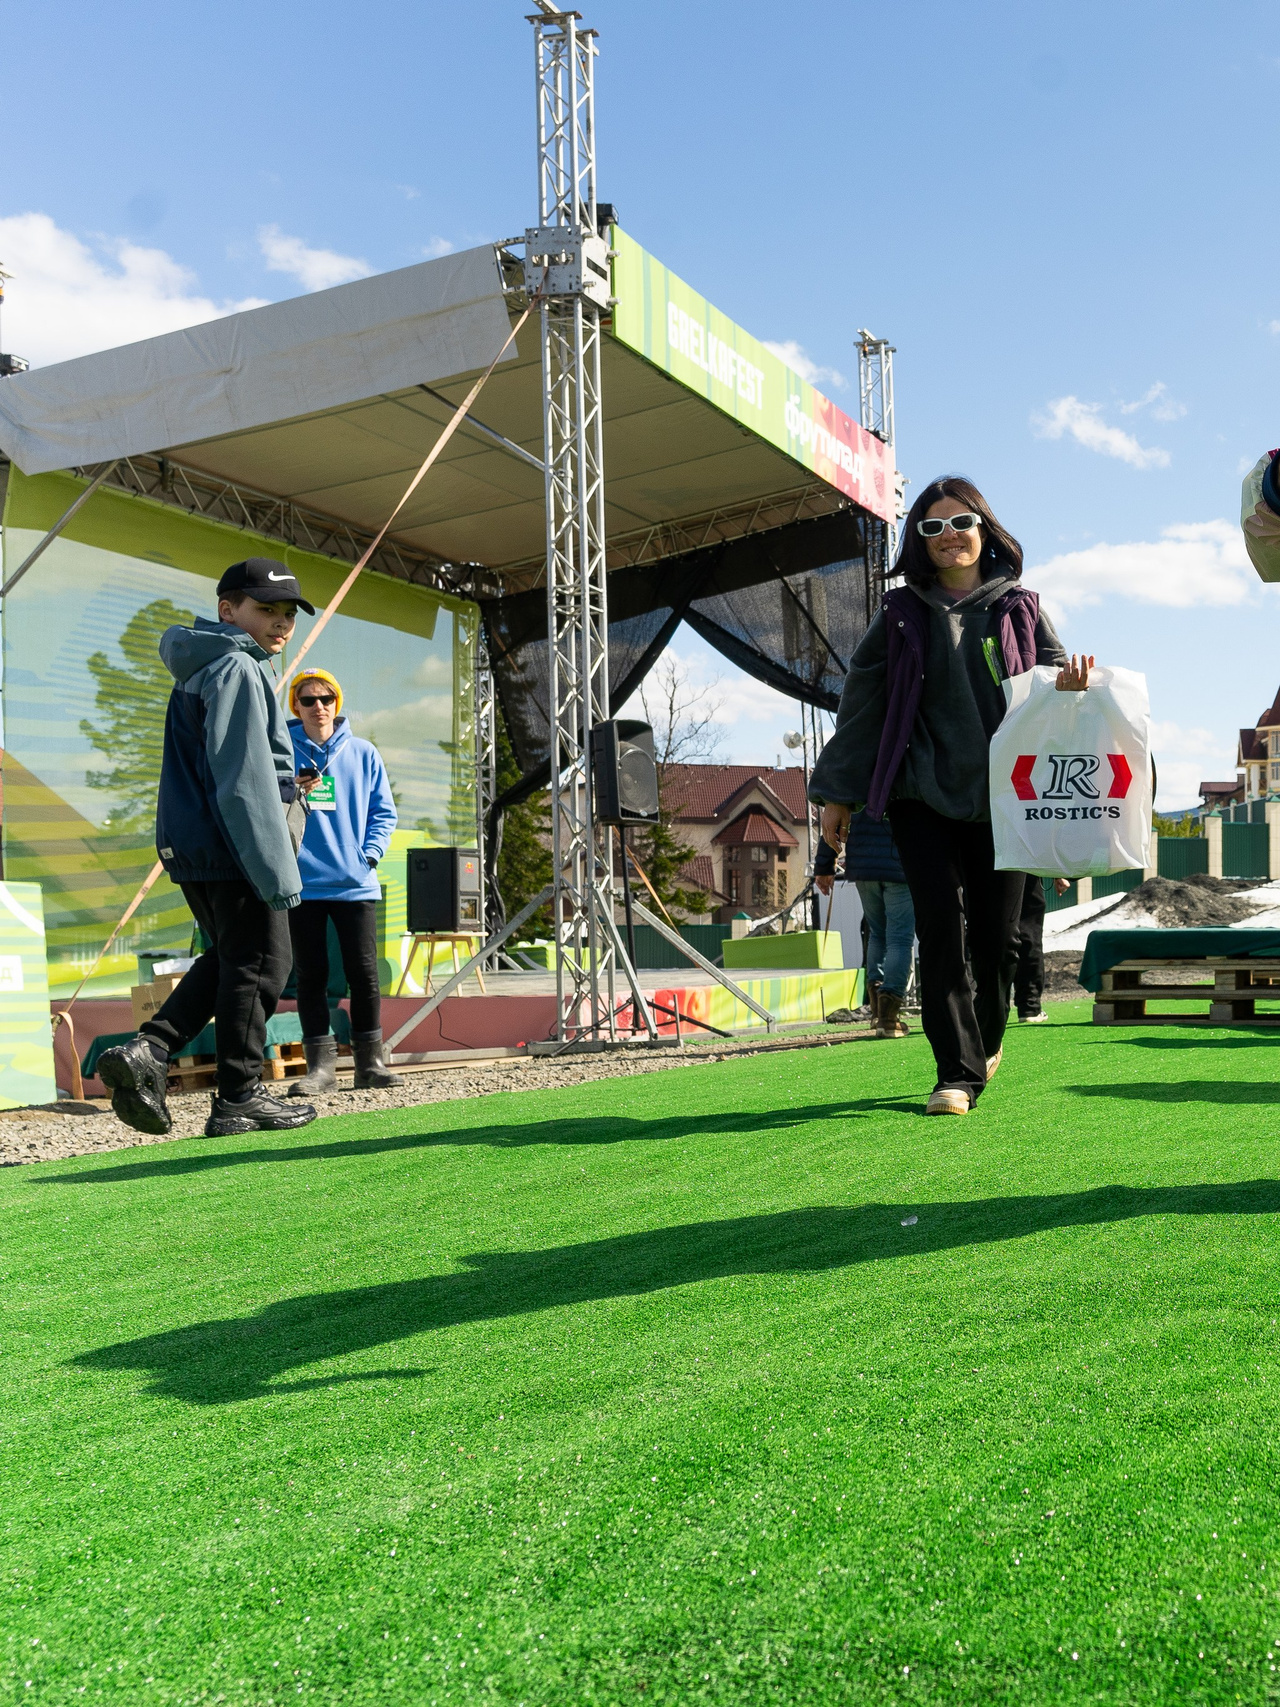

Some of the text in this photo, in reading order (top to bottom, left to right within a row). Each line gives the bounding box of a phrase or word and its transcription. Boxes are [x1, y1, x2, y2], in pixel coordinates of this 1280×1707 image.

[666, 300, 765, 411] GRELKAFEST
[1042, 754, 1101, 800] R
[1025, 805, 1121, 821] ROSTIC'S
